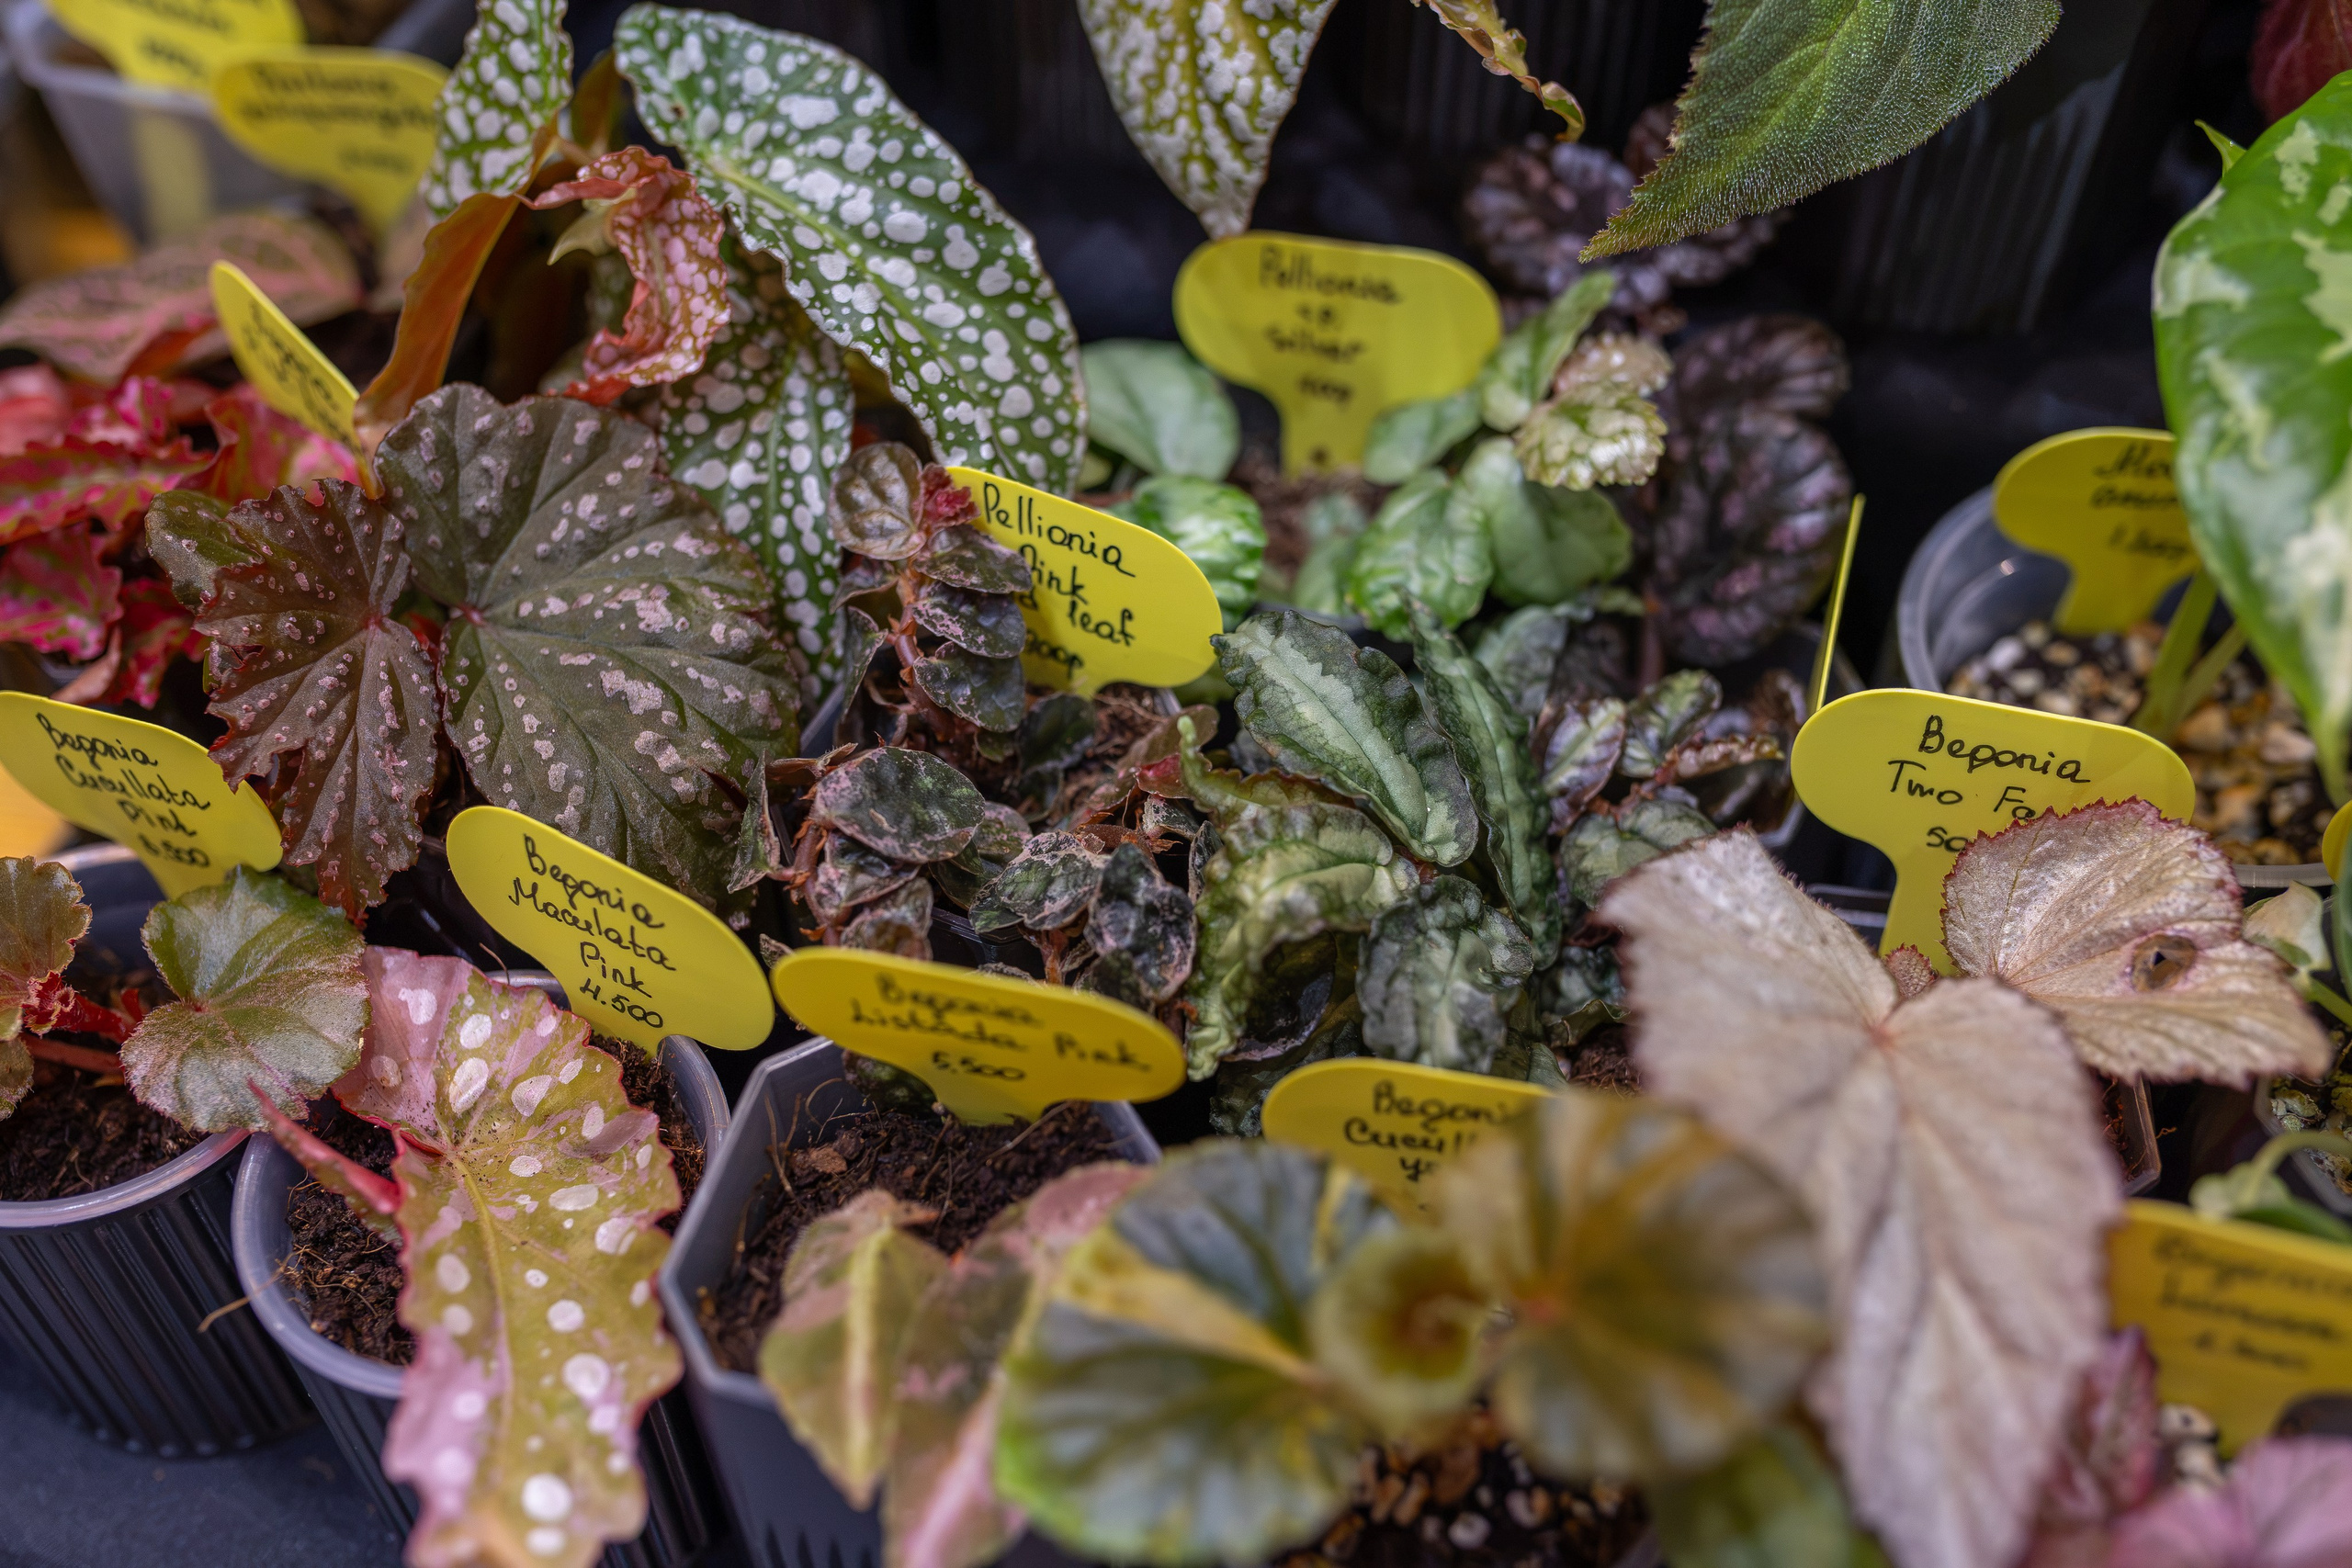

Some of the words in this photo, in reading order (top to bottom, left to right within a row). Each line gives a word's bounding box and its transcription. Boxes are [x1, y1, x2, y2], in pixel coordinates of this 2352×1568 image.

[984, 481, 1136, 578] Pellionia
[1019, 544, 1088, 605] Pink
[1069, 599, 1136, 647] leaf
[36, 712, 158, 772] Begonia
[1918, 715, 2090, 783] Begonia
[1993, 785, 2036, 822] Fa
[524, 833, 665, 929] Begonia
[508, 877, 676, 971] Maculata
[581, 942, 652, 998] Pink
[1373, 1079, 1509, 1134] Begoni
